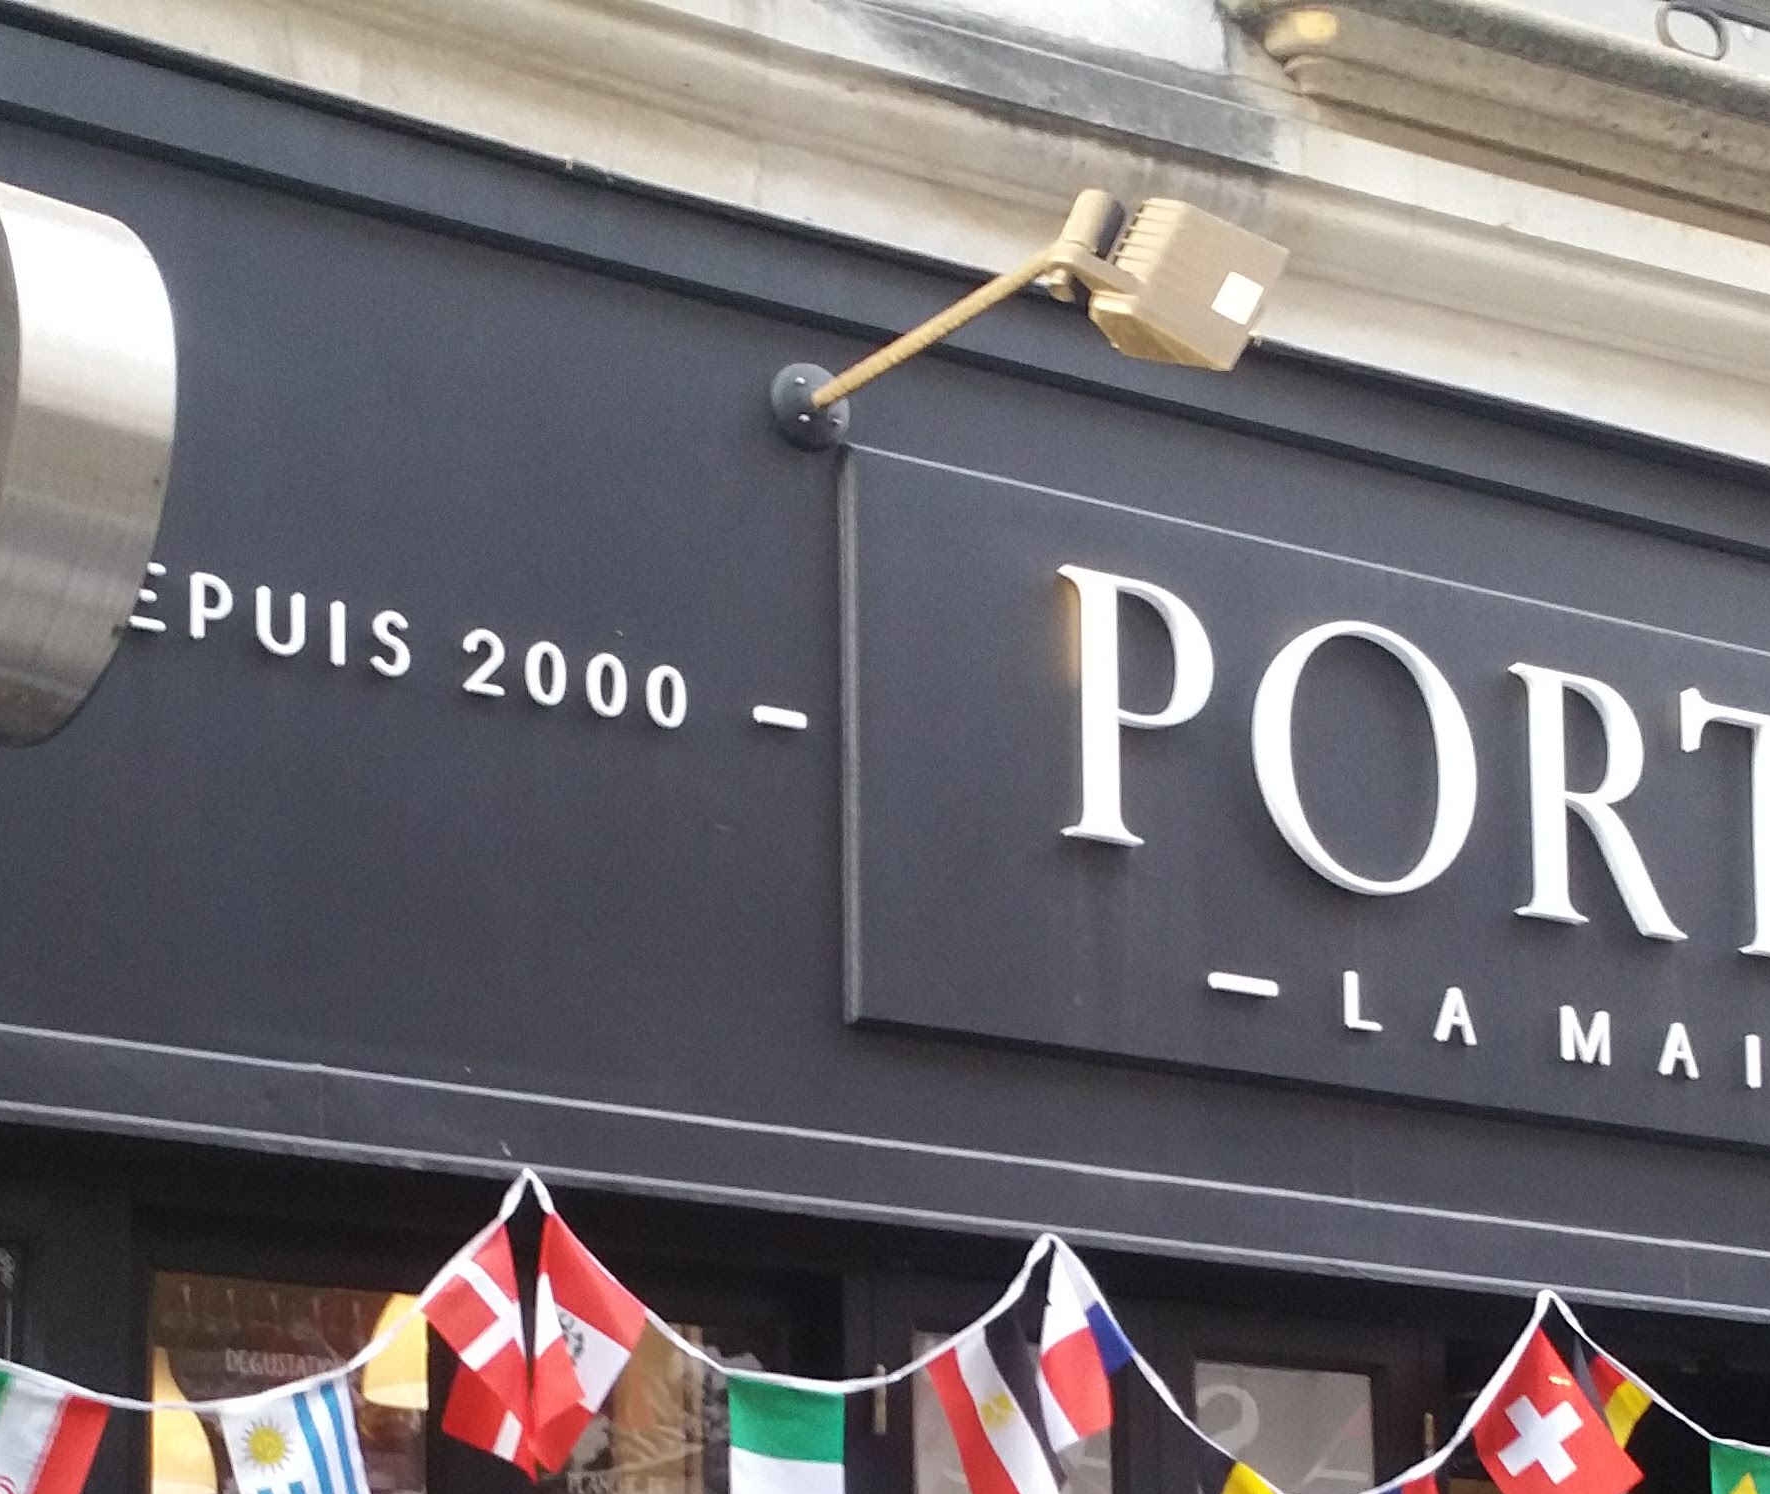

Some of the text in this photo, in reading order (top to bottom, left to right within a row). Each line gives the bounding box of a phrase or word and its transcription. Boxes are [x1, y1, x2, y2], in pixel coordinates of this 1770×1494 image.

[129, 562, 687, 729] EPUIS 2000
[1342, 971, 1478, 1047] LA
